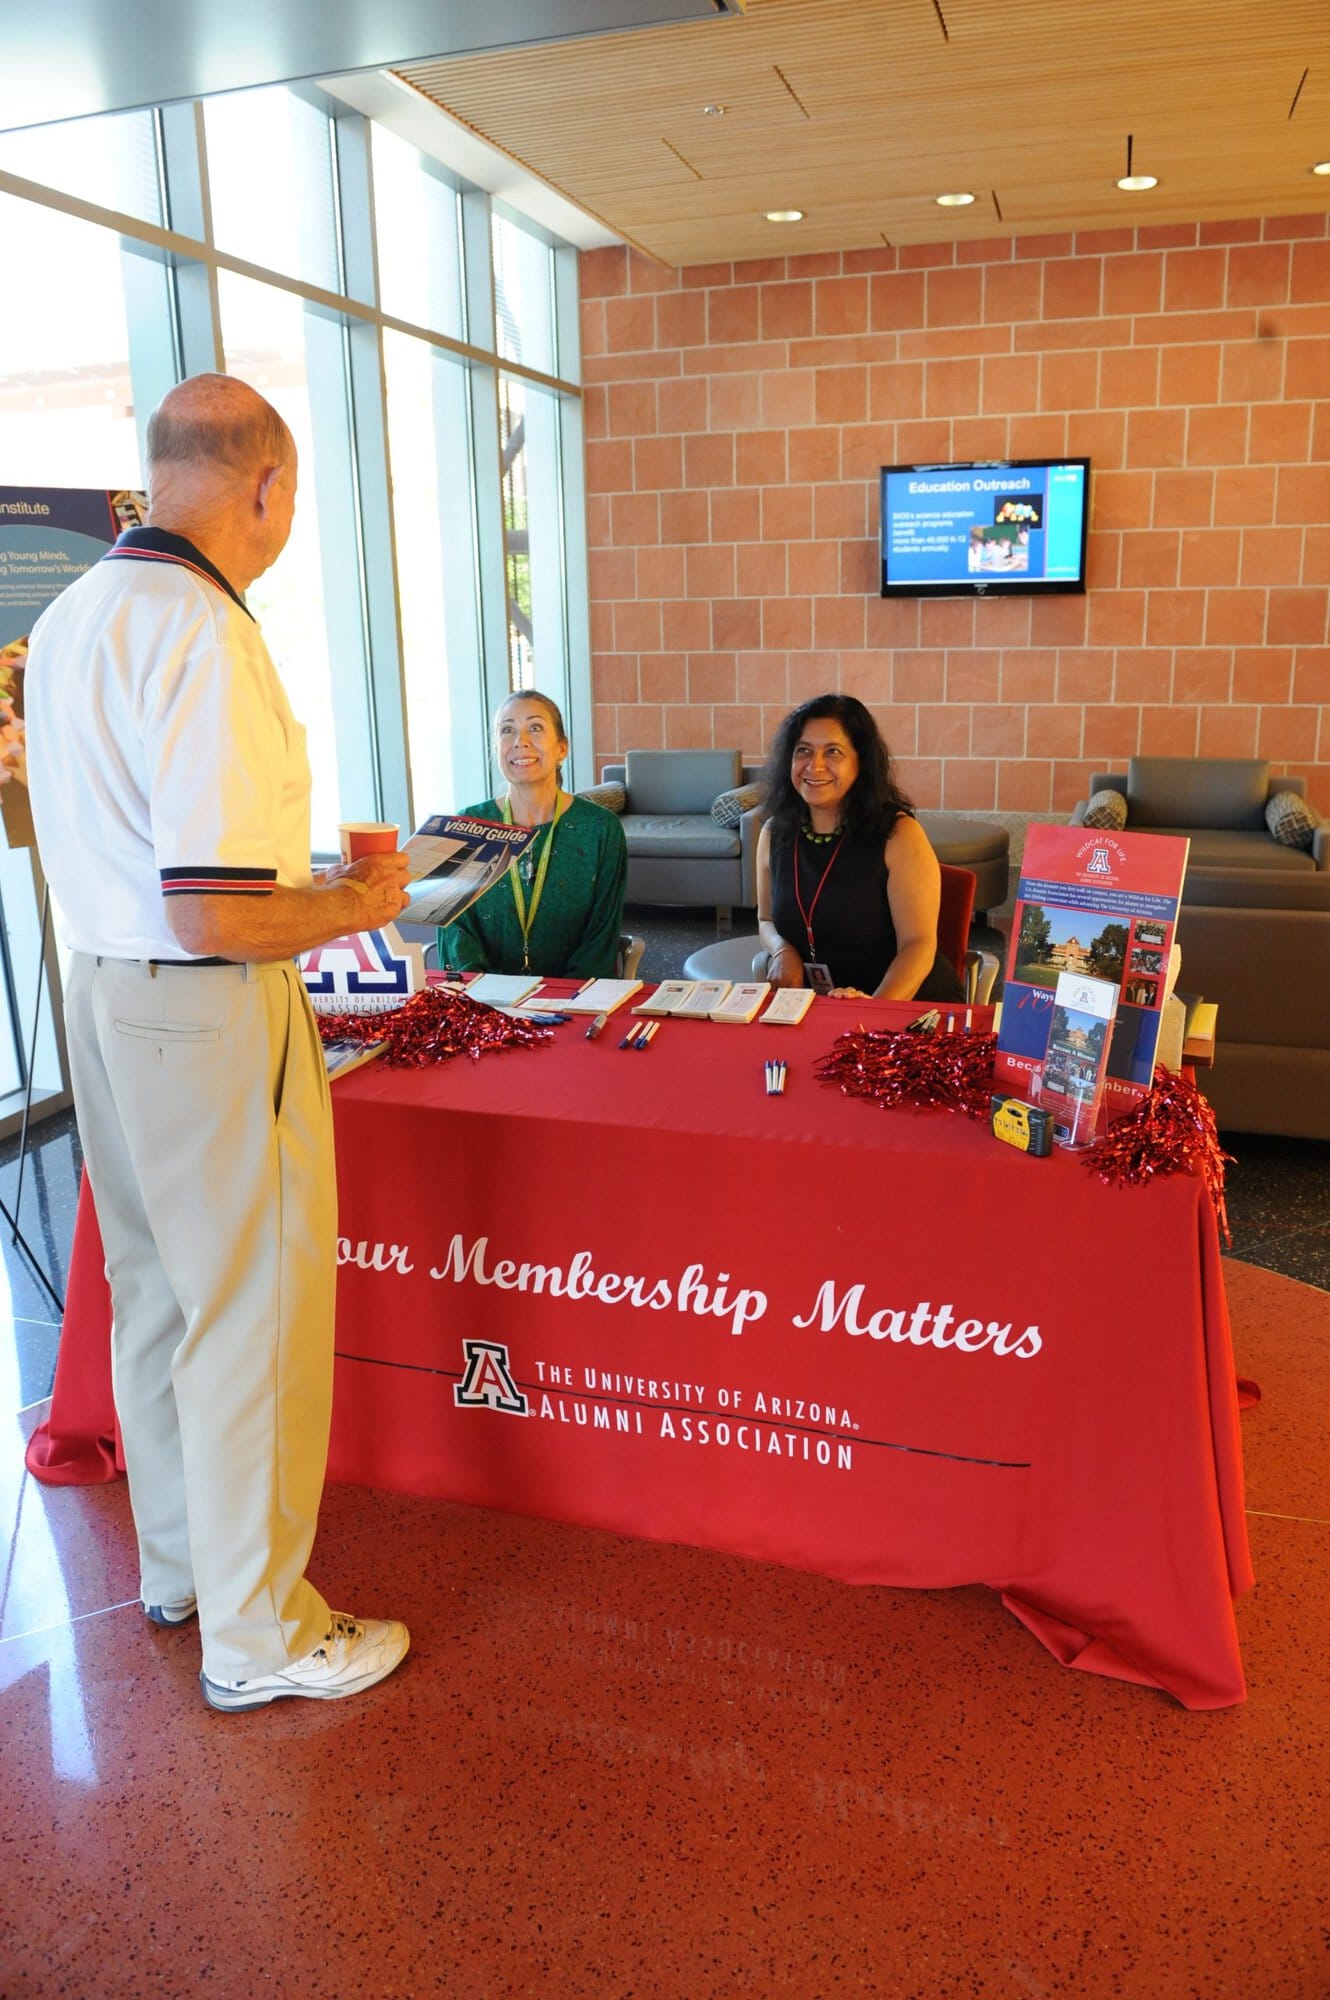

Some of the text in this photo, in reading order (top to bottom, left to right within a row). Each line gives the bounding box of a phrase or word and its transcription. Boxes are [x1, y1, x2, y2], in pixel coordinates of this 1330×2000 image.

[909, 477, 1031, 494] Education Outreach
[7, 551, 38, 563] Young
[7, 564, 61, 573] Tomorrow's
[1076, 837, 1104, 859] WILDCAT
[1104, 838, 1119, 850] FOR
[1087, 848, 1111, 874] A
[1032, 988, 1054, 1002] Ways
[337, 1234, 1043, 1358] our Membership Matters
[535, 1361, 573, 1386] THE
[584, 1368, 705, 1404] UNIVERSITY
[718, 1388, 742, 1409] OF
[540, 1394, 852, 1470] ALUMNI ASSOCIATION
